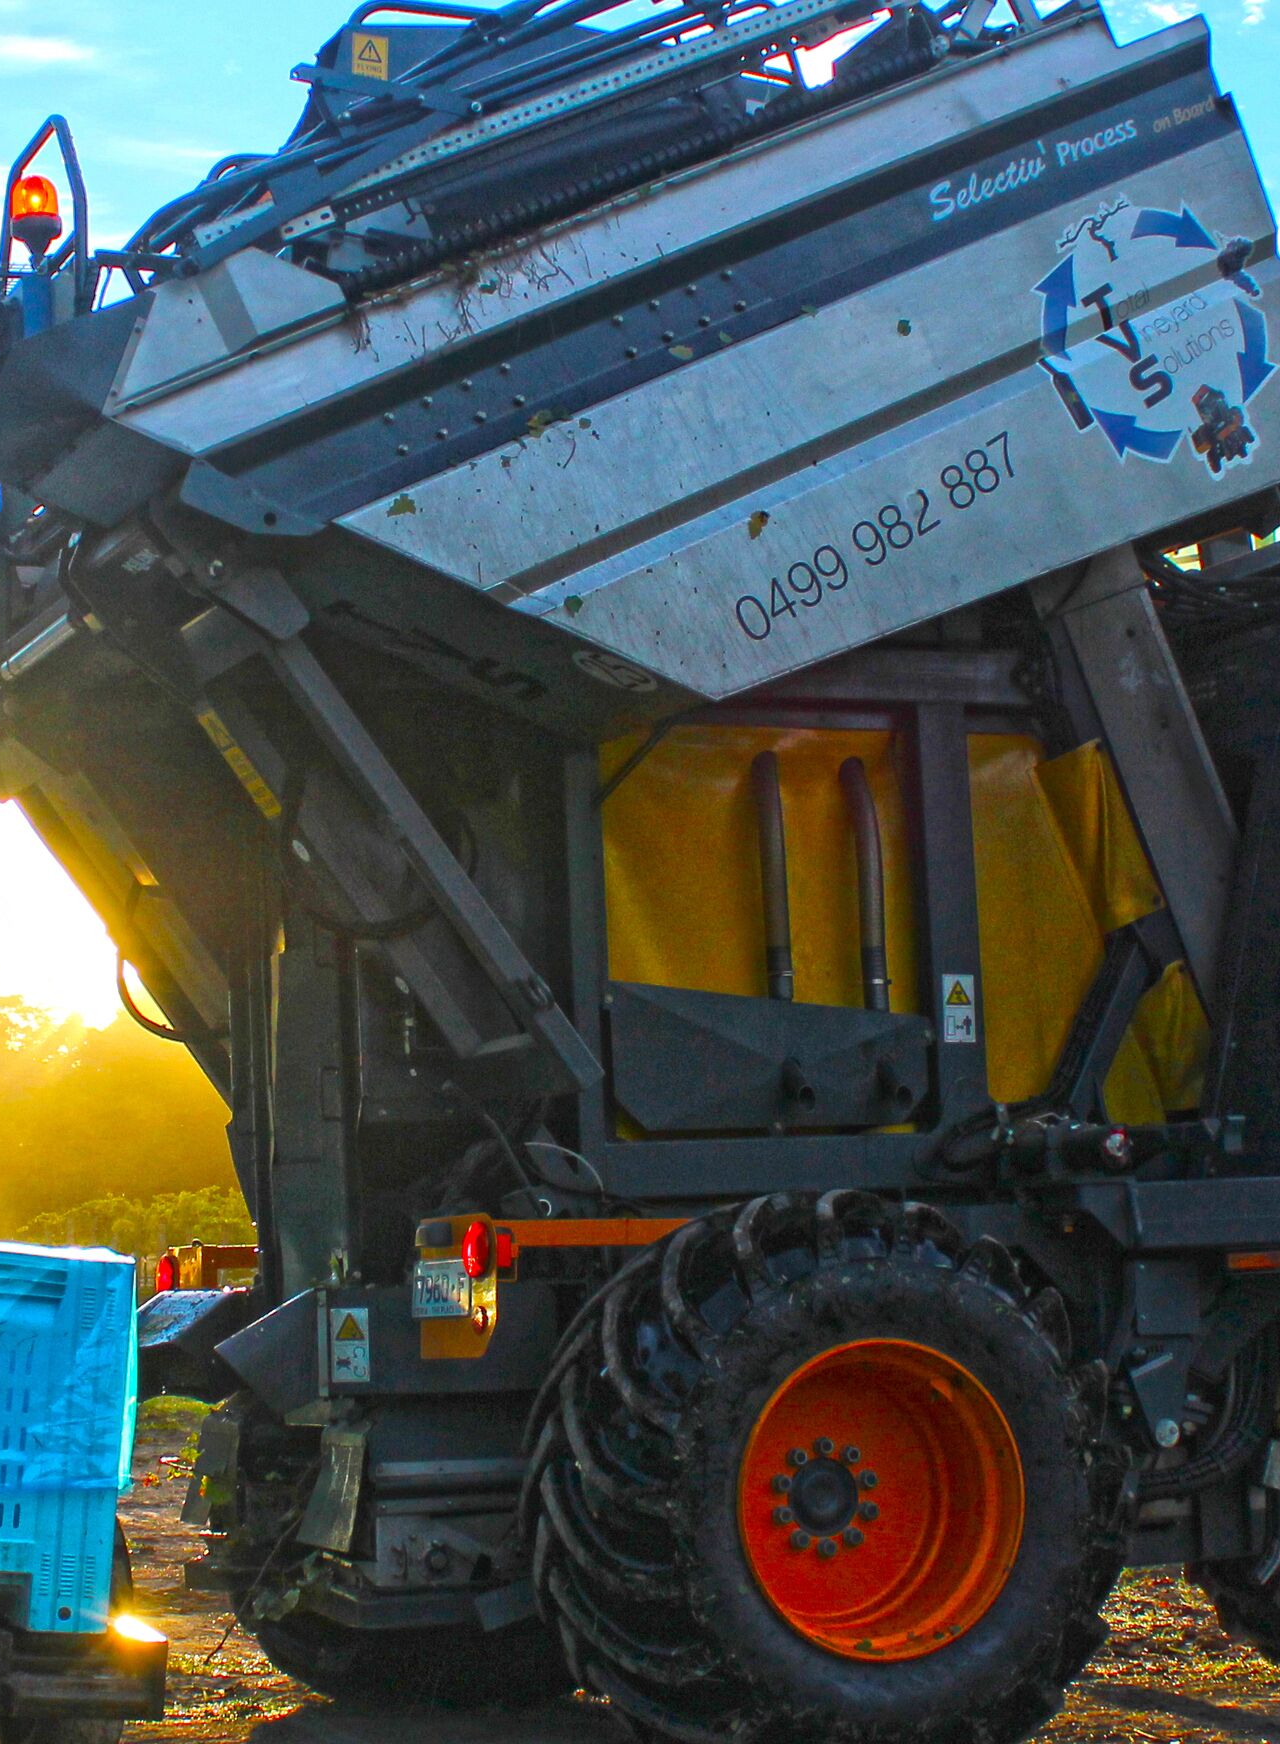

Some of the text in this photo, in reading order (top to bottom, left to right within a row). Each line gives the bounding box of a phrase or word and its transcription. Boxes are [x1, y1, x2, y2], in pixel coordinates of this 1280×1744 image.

[1055, 119, 1138, 167] Process
[1153, 119, 1172, 134] on
[1174, 96, 1216, 125] Board
[735, 431, 1015, 641] 0499 982 887
